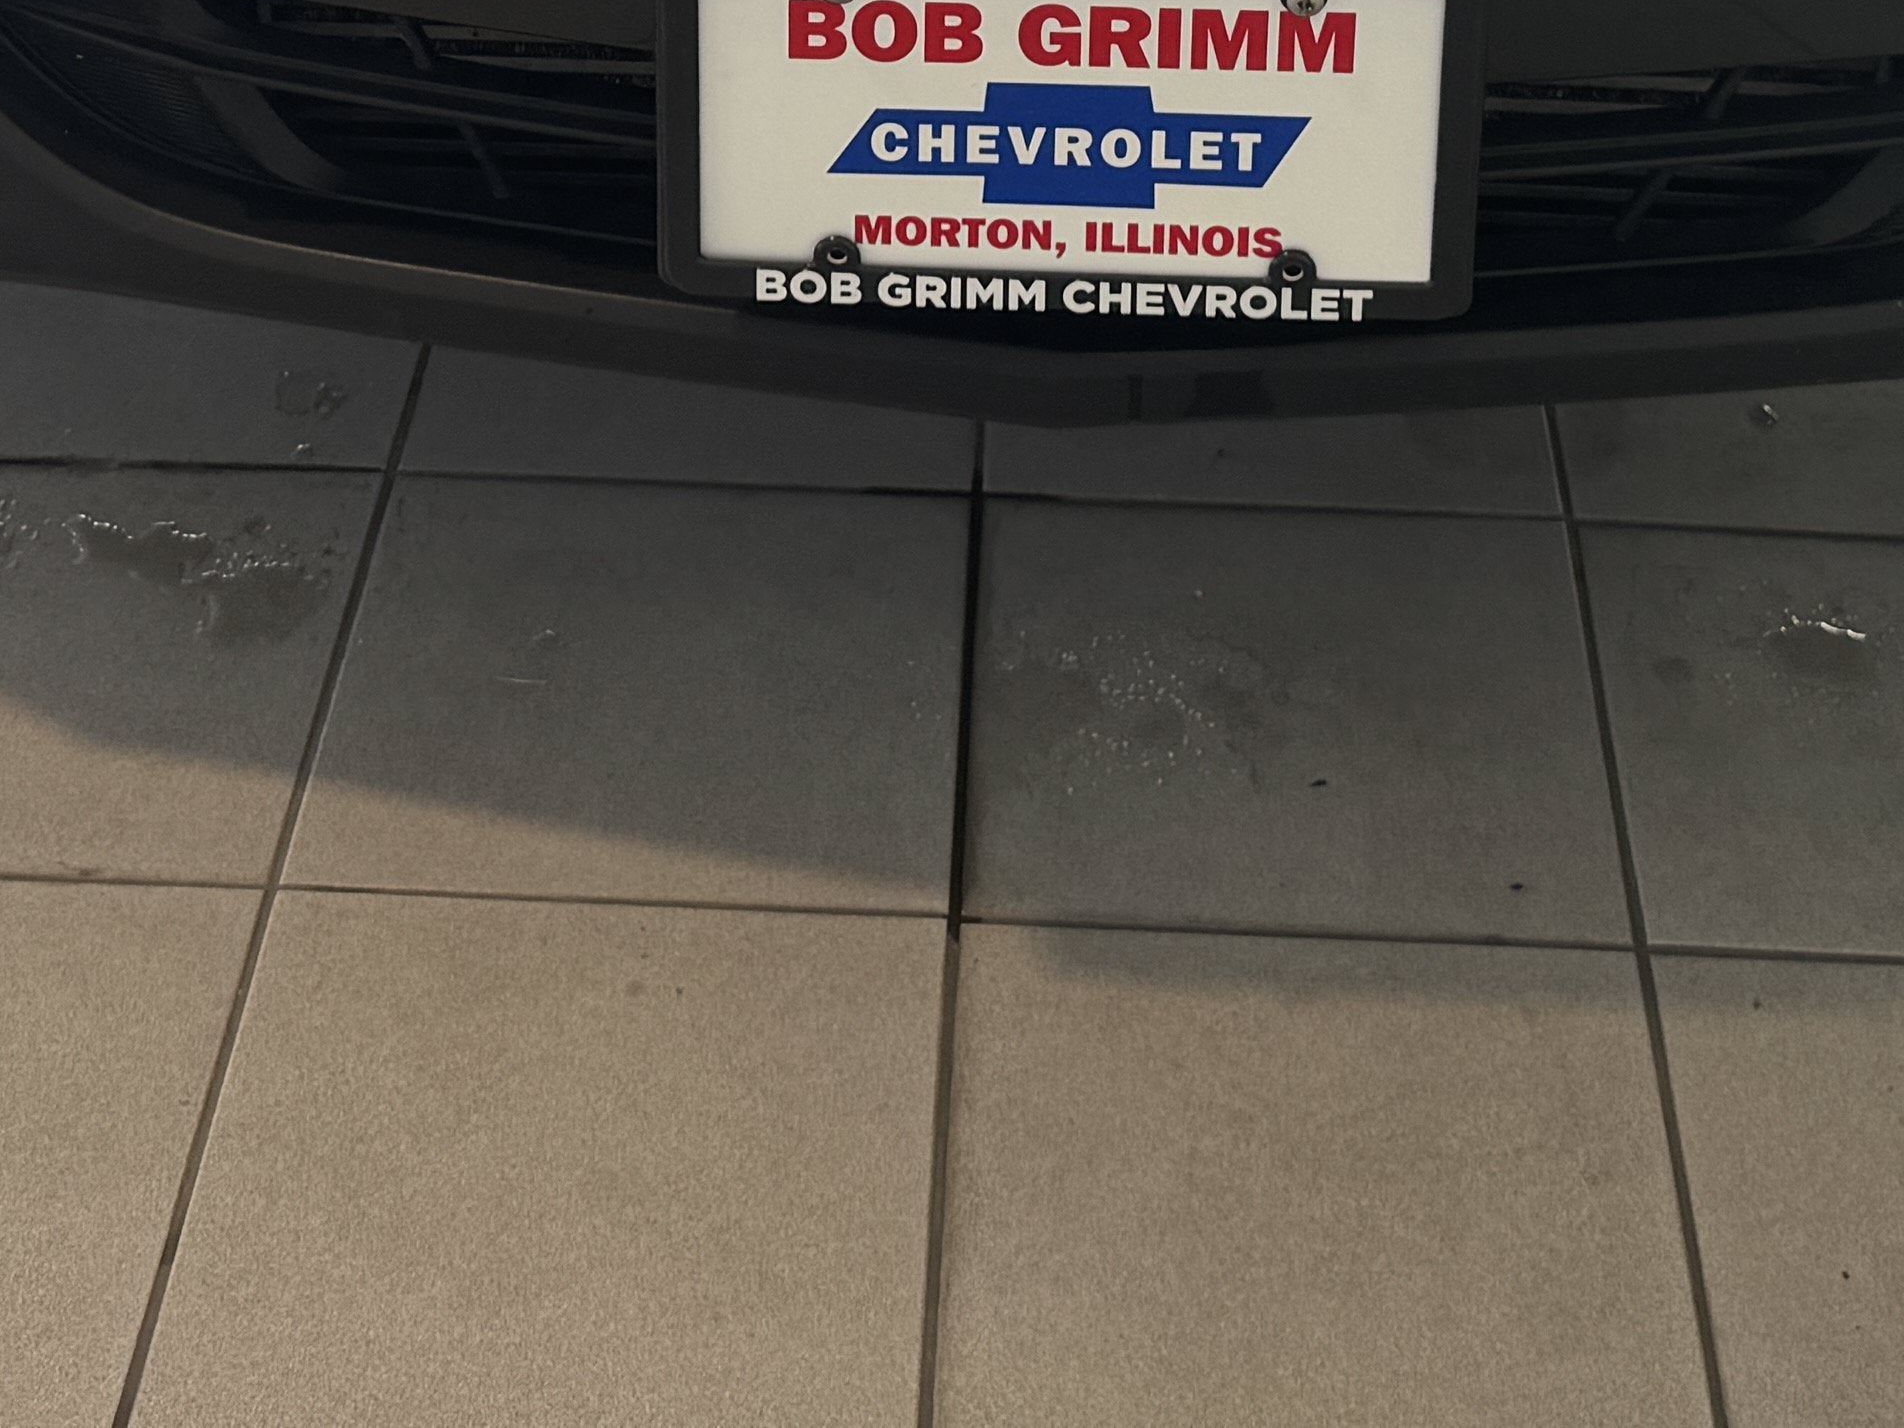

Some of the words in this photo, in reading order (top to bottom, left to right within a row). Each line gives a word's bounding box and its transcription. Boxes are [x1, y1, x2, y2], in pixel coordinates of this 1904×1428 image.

[1018, 4, 1357, 74] GRIMM
[870, 122, 1263, 173] CHEVROLET
[853, 214, 1067, 258] MORTON,
[1085, 221, 1283, 259] ILLINOIS
[754, 268, 862, 305] BOB
[877, 273, 1047, 312] GRIMM
[1062, 280, 1374, 323] CHEVROLET
